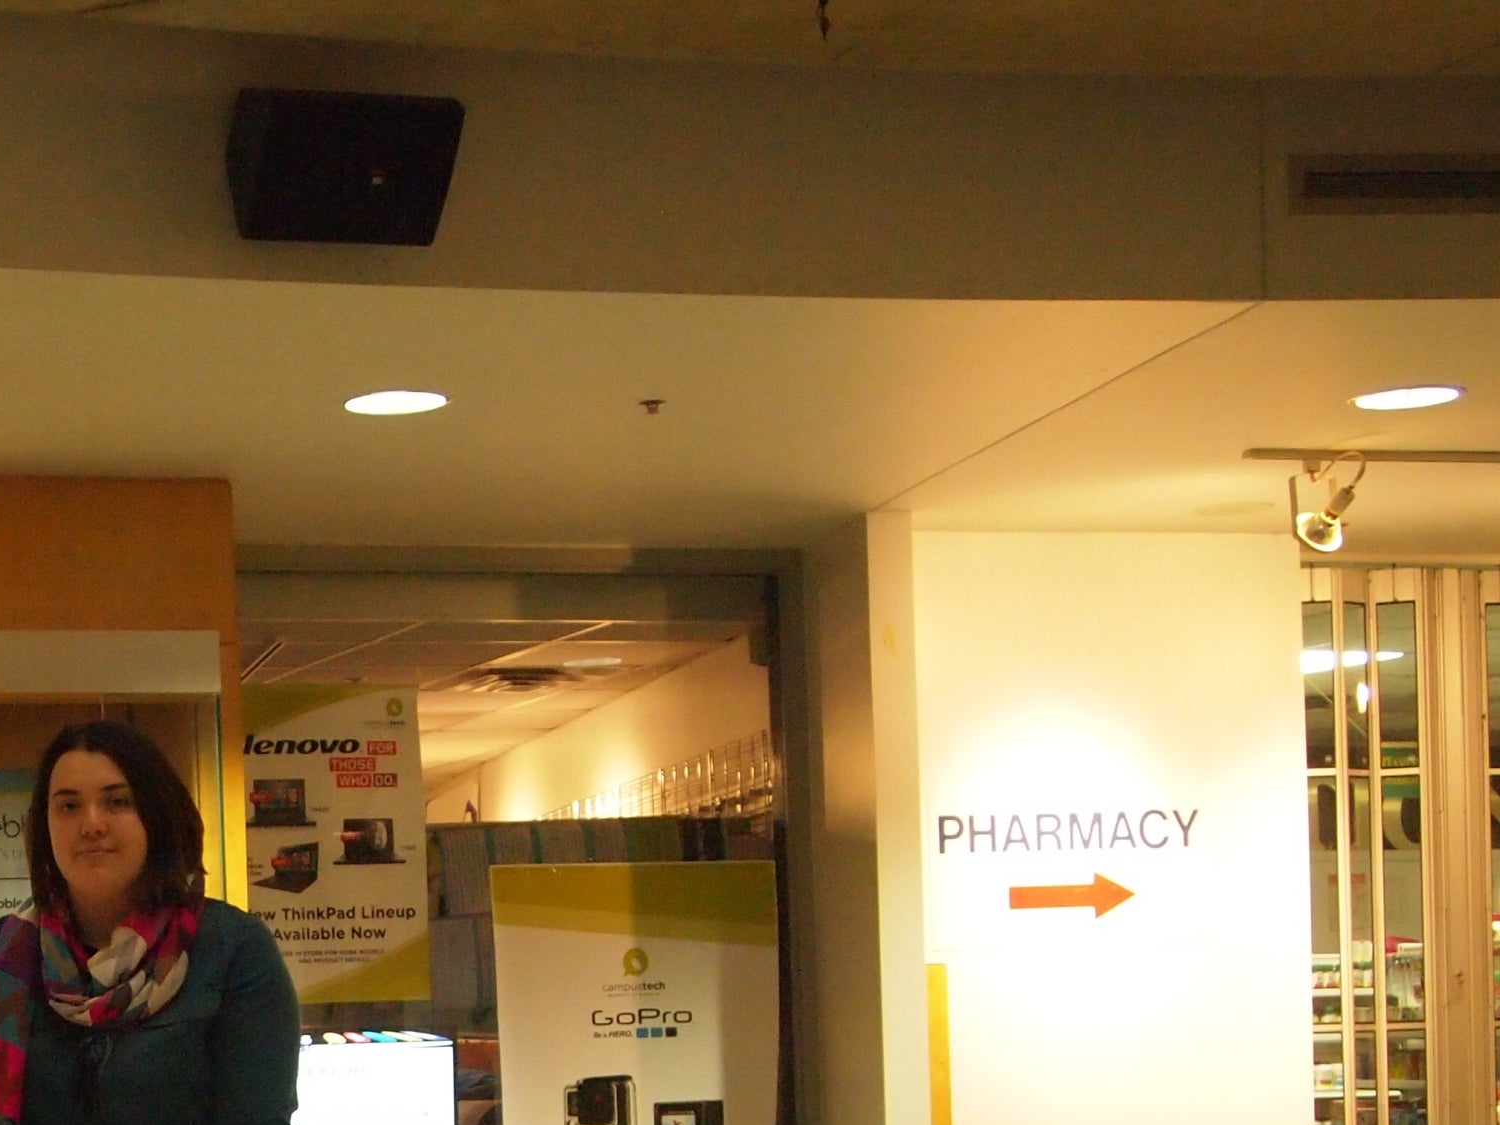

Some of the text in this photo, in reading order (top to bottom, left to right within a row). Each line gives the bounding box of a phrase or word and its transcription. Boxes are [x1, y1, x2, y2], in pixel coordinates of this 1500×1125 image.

[243, 734, 396, 755] lenovo FOR
[332, 759, 375, 771] THOSE
[339, 776, 370, 787] WHO
[938, 808, 1199, 854] PHARMACY
[281, 906, 356, 920] ThinkPad
[361, 906, 416, 920] Lineup
[274, 926, 387, 941] Available Now
[602, 982, 666, 993] campustech
[591, 1007, 693, 1026] GoPro
